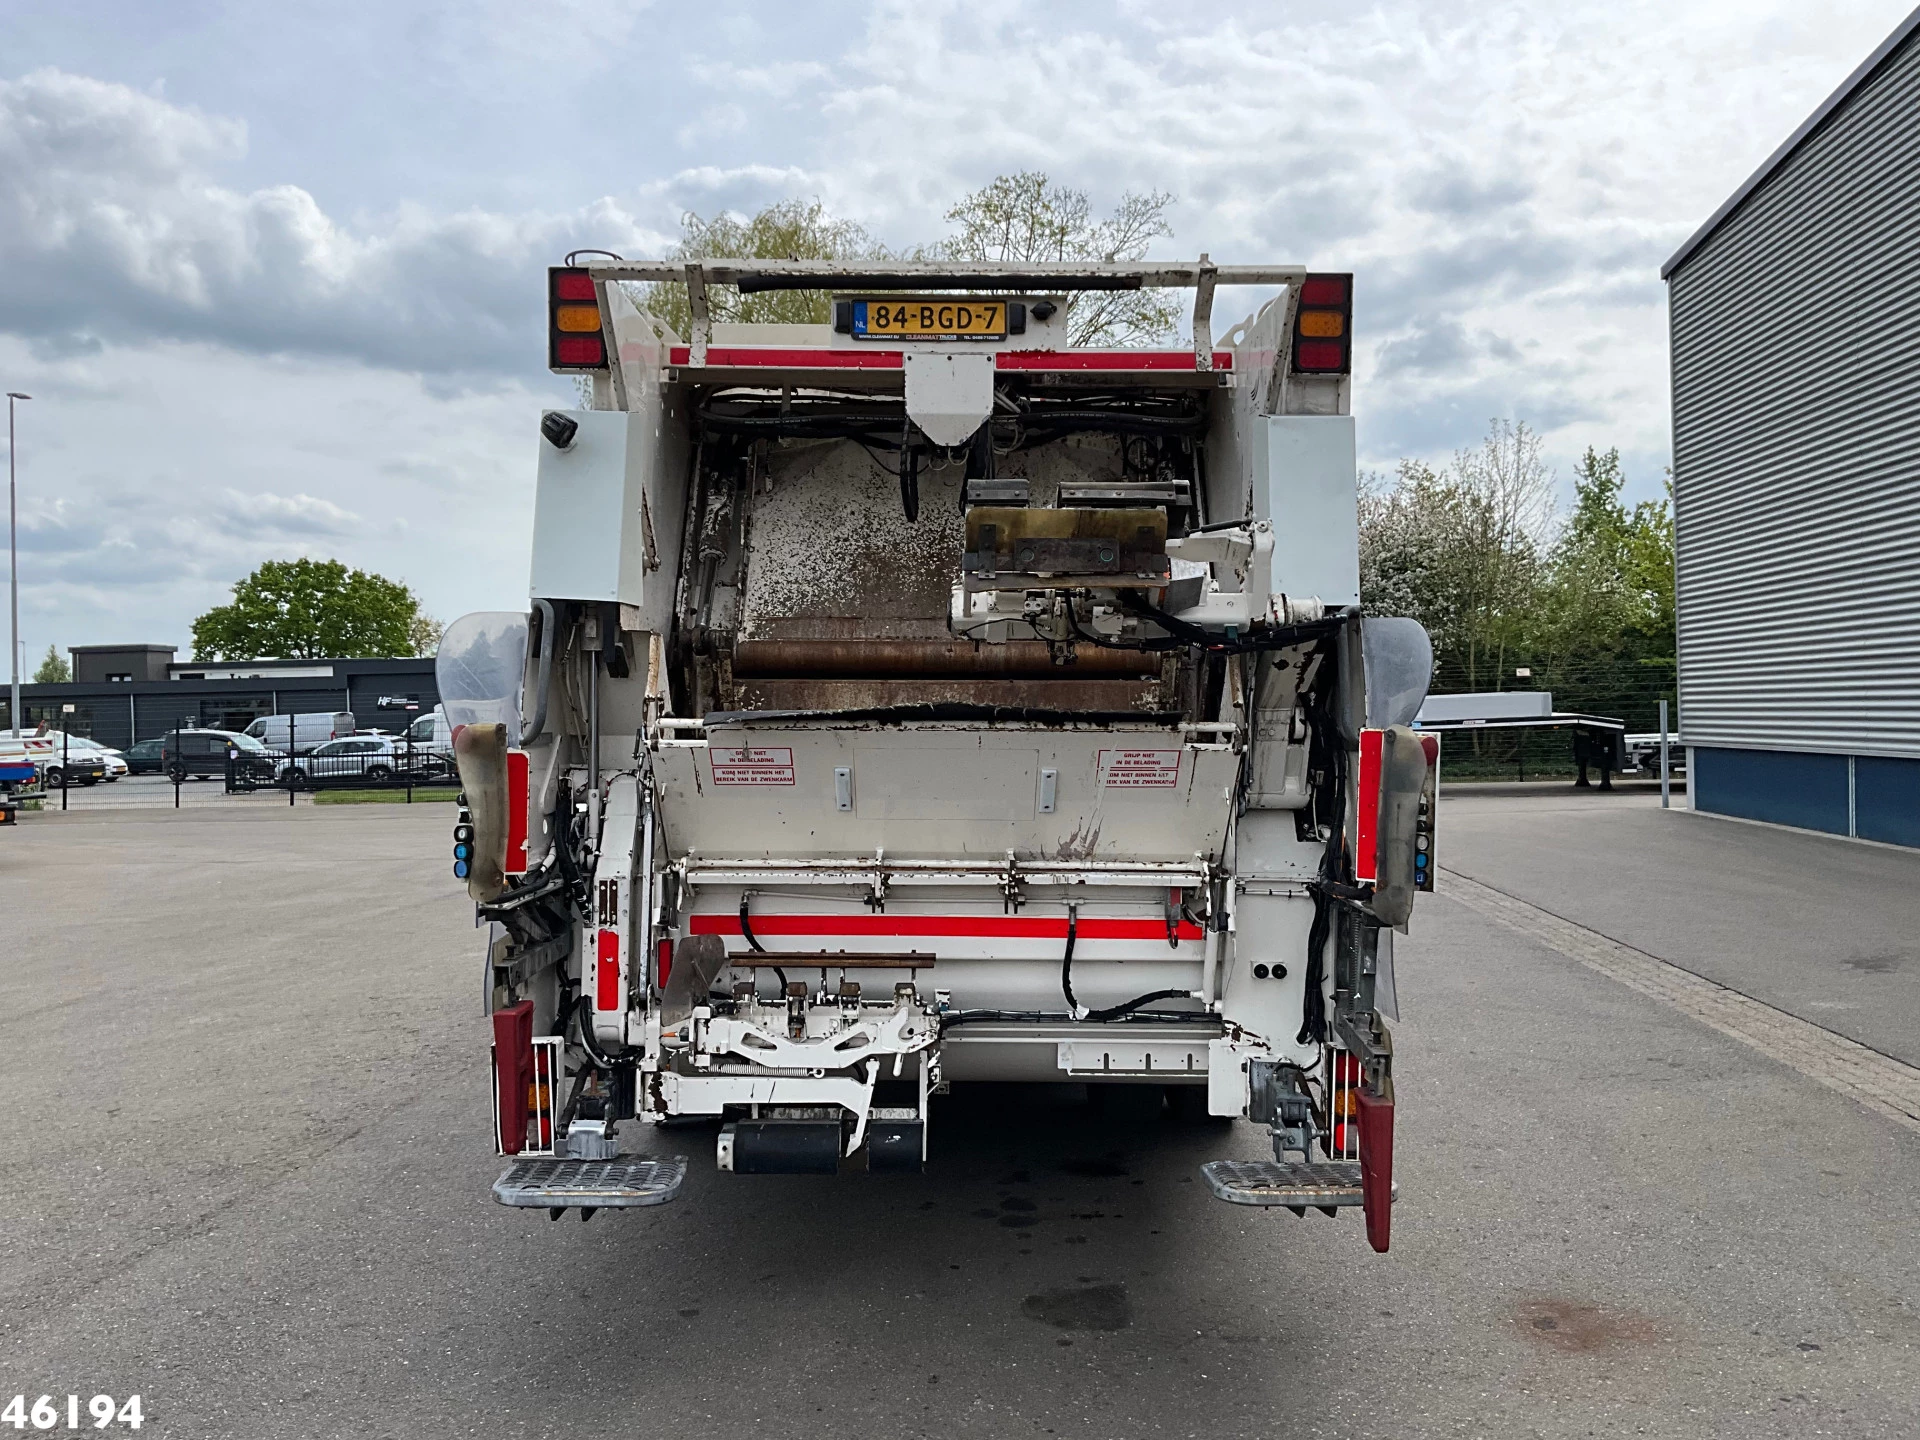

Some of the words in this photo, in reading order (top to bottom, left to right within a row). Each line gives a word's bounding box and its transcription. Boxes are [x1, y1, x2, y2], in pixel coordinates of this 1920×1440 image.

[875, 305, 998, 329] 84-BGD-7
[855, 320, 866, 329] NL
[377, 696, 392, 706] HF
